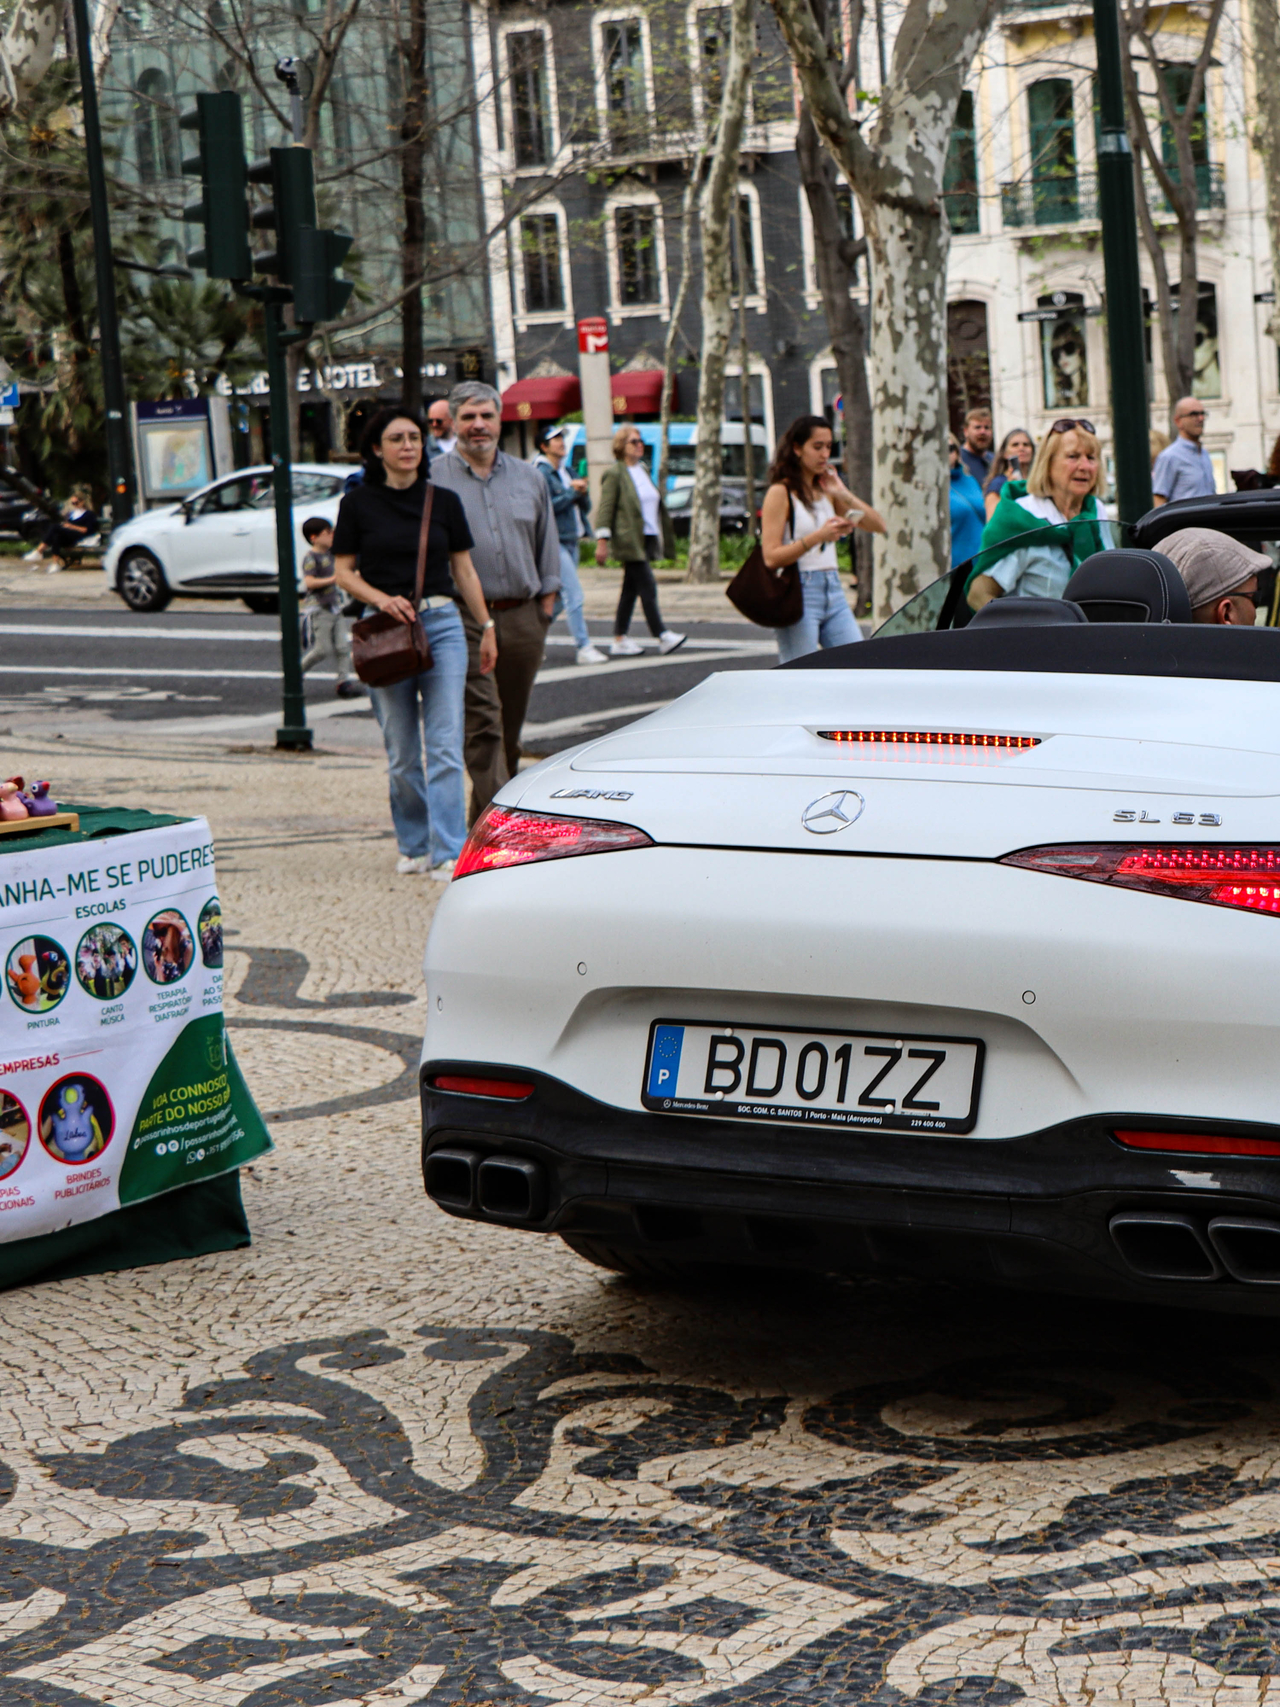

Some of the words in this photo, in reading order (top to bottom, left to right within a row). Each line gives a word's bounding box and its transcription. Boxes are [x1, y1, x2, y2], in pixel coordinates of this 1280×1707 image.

[315, 362, 383, 391] HOTEL
[1113, 810, 1160, 823] SL
[1172, 812, 1222, 827] 63
[106, 862, 133, 888] SE
[75, 898, 126, 919] ESCOLAS
[157, 987, 188, 1000] TERAPIA
[204, 986, 216, 996] AO
[101, 1003, 124, 1015] CANTO
[27, 1017, 60, 1030] PINTURA
[100, 1013, 125, 1026] MÚSICA
[657, 1069, 670, 1085] P
[165, 1105, 185, 1121] DO
[188, 1094, 223, 1116] NOSSO
[738, 1105, 752, 1113] SOC.
[753, 1106, 769, 1115] COM.
[770, 1108, 777, 1116] C.
[778, 1108, 802, 1118] SANTOS
[809, 1111, 827, 1120] Porto
[831, 1113, 846, 1122] Maia
[847, 1114, 882, 1125] (Aeroporto)
[66, 1168, 102, 1184] BRINDES
[54, 1176, 111, 1199] PUBLICITÁRIOS
